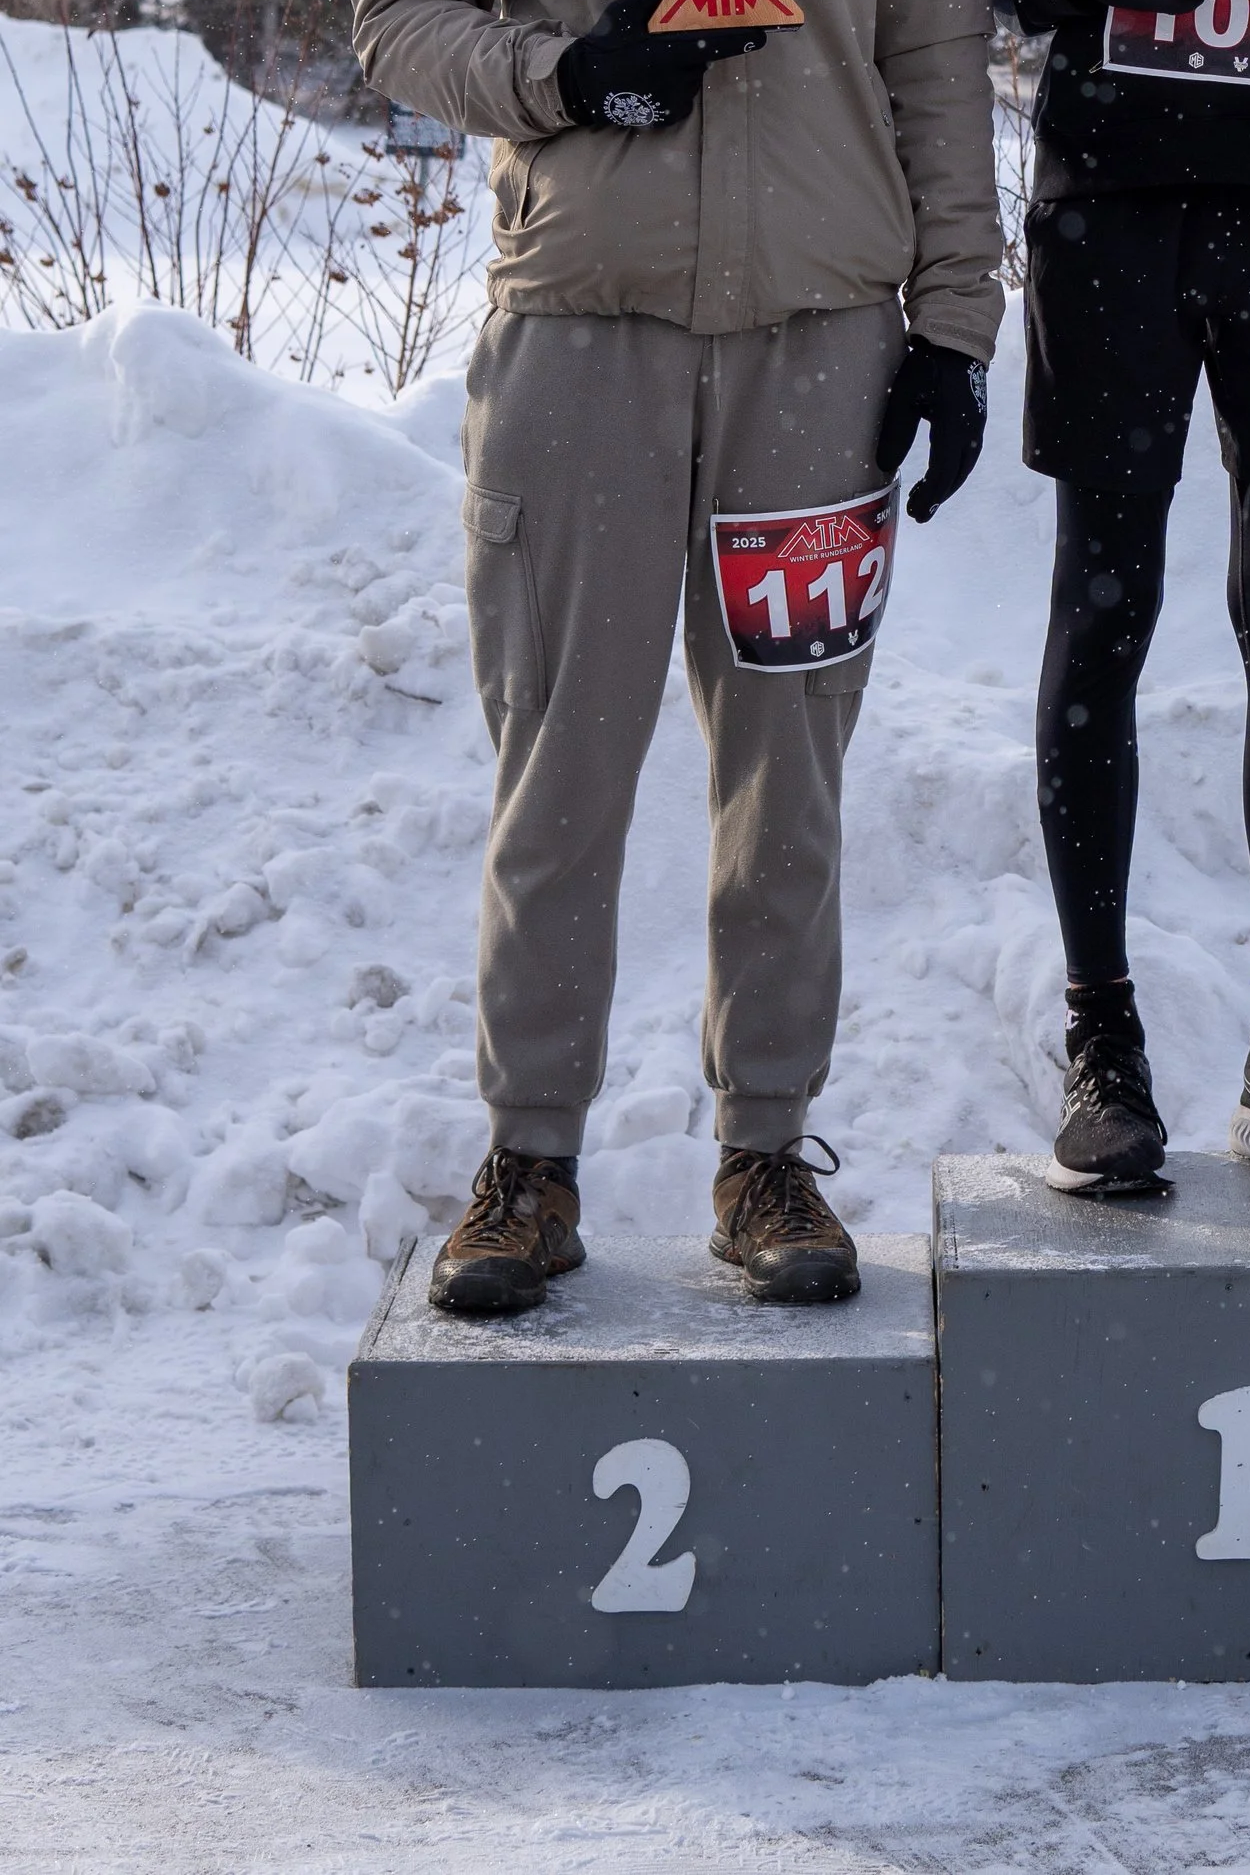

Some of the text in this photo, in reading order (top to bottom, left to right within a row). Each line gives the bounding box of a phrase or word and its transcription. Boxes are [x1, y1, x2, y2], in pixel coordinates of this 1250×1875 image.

[732, 537, 766, 549] 2025
[778, 515, 870, 558] MTM
[790, 543, 863, 563] WINTER RUNDERLAND
[748, 545, 886, 639] 112
[592, 1438, 696, 1613] 2
